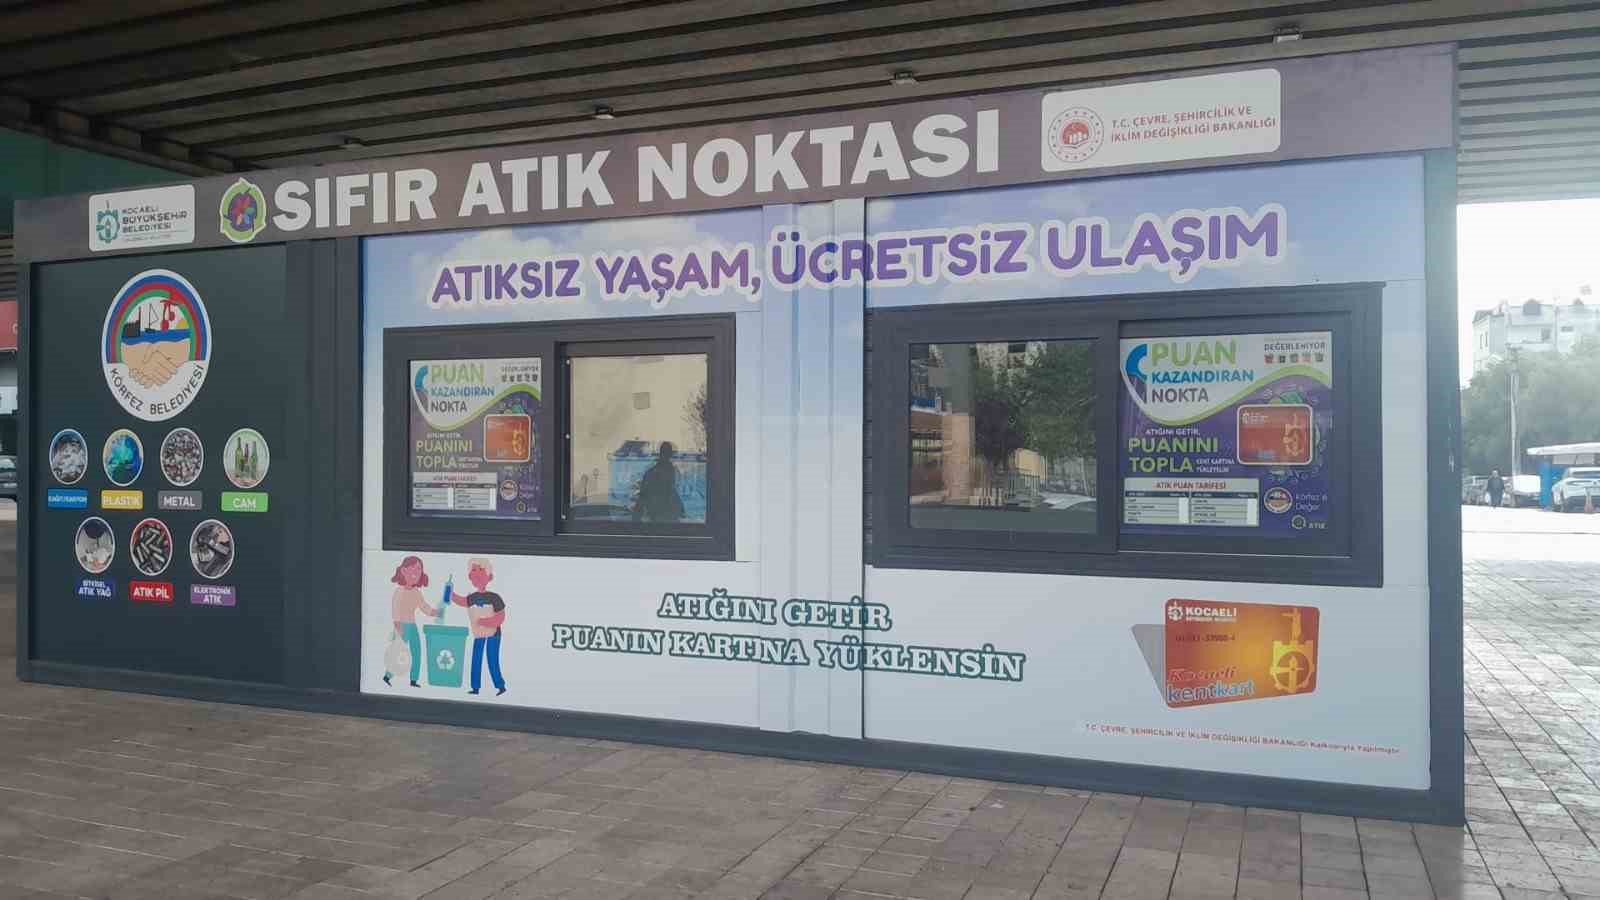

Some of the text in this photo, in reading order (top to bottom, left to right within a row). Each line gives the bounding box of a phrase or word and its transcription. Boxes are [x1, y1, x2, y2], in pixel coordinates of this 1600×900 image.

[1111, 118, 1130, 129] T.C.
[1173, 104, 1236, 123] ŞEHİRCİLİK
[1237, 105, 1252, 116] VE
[1110, 117, 1277, 144] İKLİM DEĞİŞİKLİĞİ BAKANLIĞI
[272, 109, 1000, 232] SIFIR ATIK NOKTASI
[431, 259, 582, 303] ATIKSIZ
[594, 248, 762, 303] YAŞAM,
[1047, 210, 1279, 277] ULAŞIM
[1151, 340, 1237, 368] PUAN
[430, 362, 485, 385] PUAN
[1151, 369, 1254, 384] KAZANDIRAN
[430, 385, 496, 399] KAZANDIRAN
[1151, 387, 1209, 404] NOKTA
[430, 399, 468, 415] NOKTA
[415, 439, 473, 453] PUANINI
[1128, 437, 1218, 453] PUANINI
[415, 455, 458, 469] TOPLA
[1128, 456, 1193, 473] TOPLA
[163, 496, 196, 507] METAL
[232, 497, 257, 509] CAM
[133, 585, 170, 599] ATIK PİL
[202, 595, 222, 605] ATIK
[657, 587, 893, 632] ATIĞINI GETİR
[551, 623, 1026, 682] PUANIN KARTINA YÜKLENSİN
